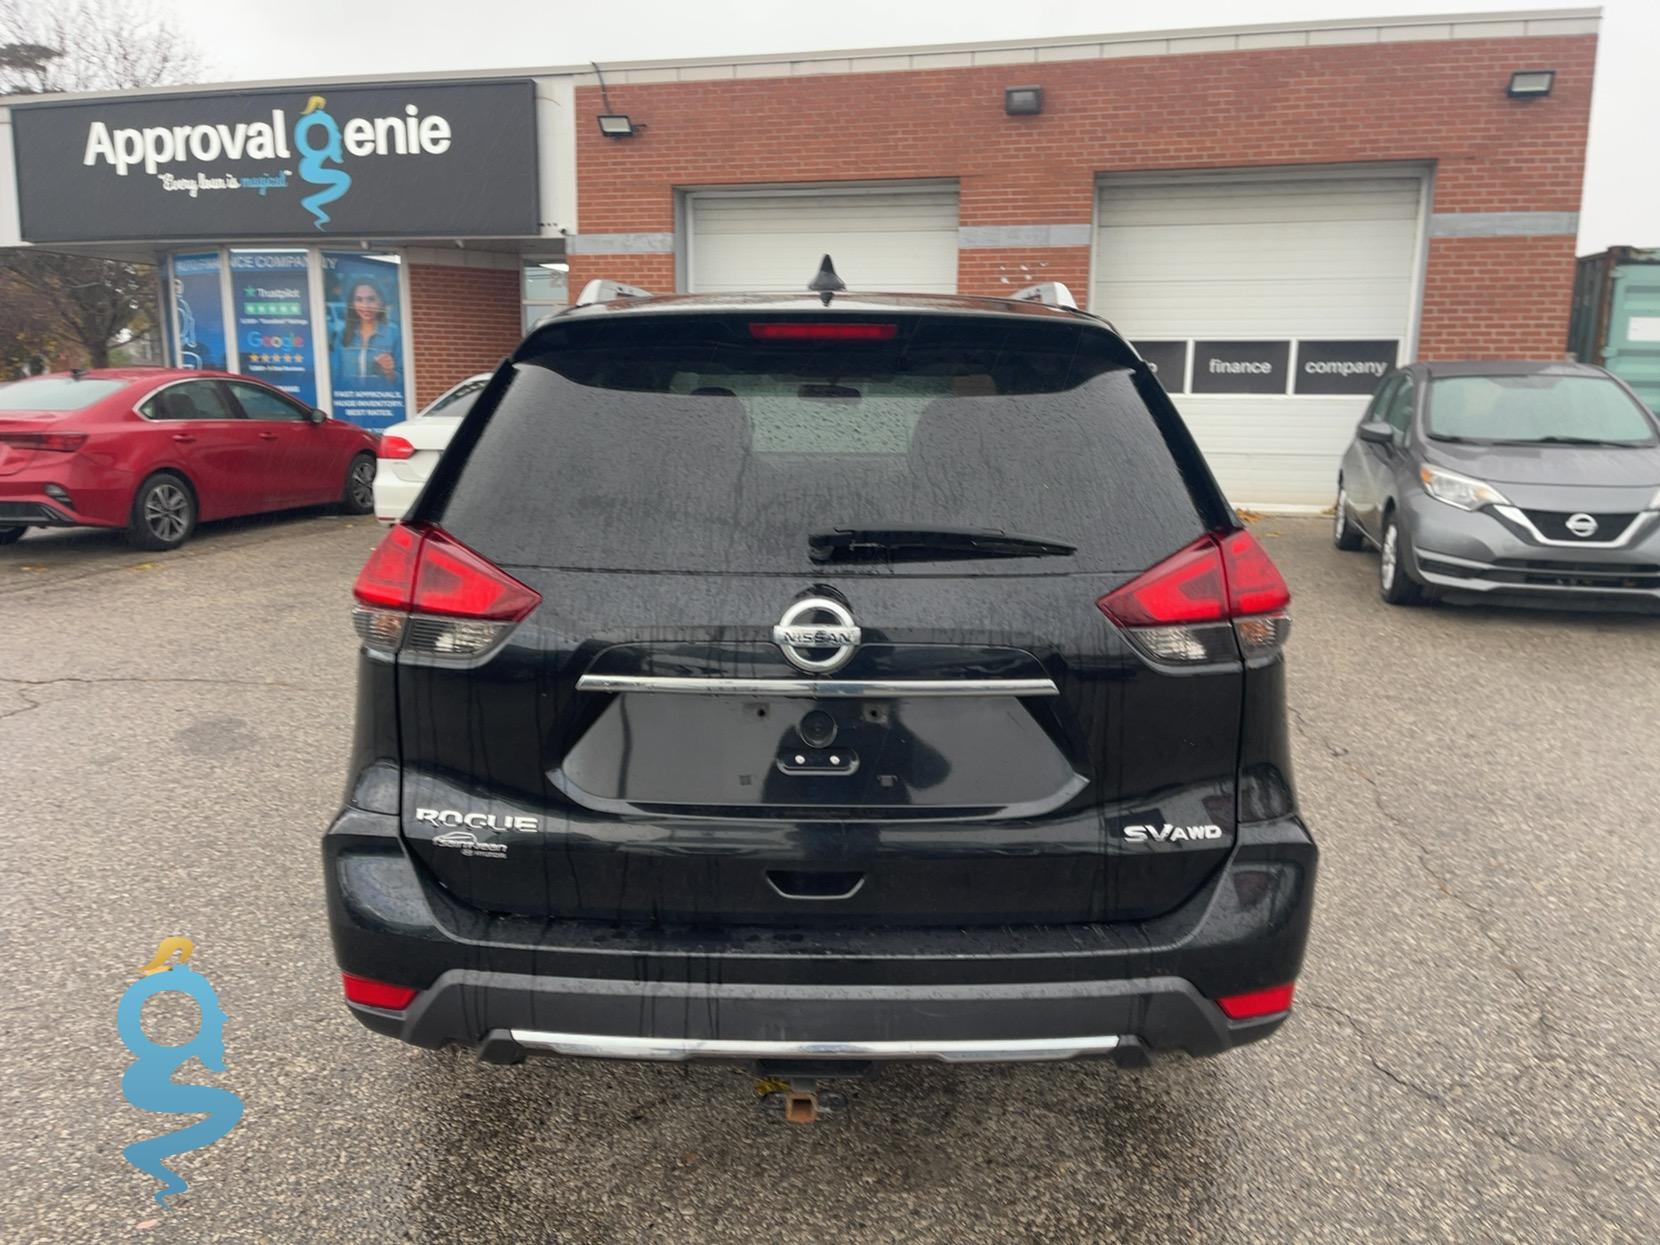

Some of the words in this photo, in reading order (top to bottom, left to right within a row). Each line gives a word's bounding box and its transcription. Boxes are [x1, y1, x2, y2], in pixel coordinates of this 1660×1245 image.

[83, 108, 291, 176] Approval
[247, 331, 304, 352] Google
[1208, 358, 1273, 374] finance
[1304, 359, 1388, 377] company
[783, 631, 852, 644] NISSAN
[415, 807, 539, 833] ROGUE
[1123, 823, 1173, 842] SV
[1169, 824, 1223, 842] AWD
